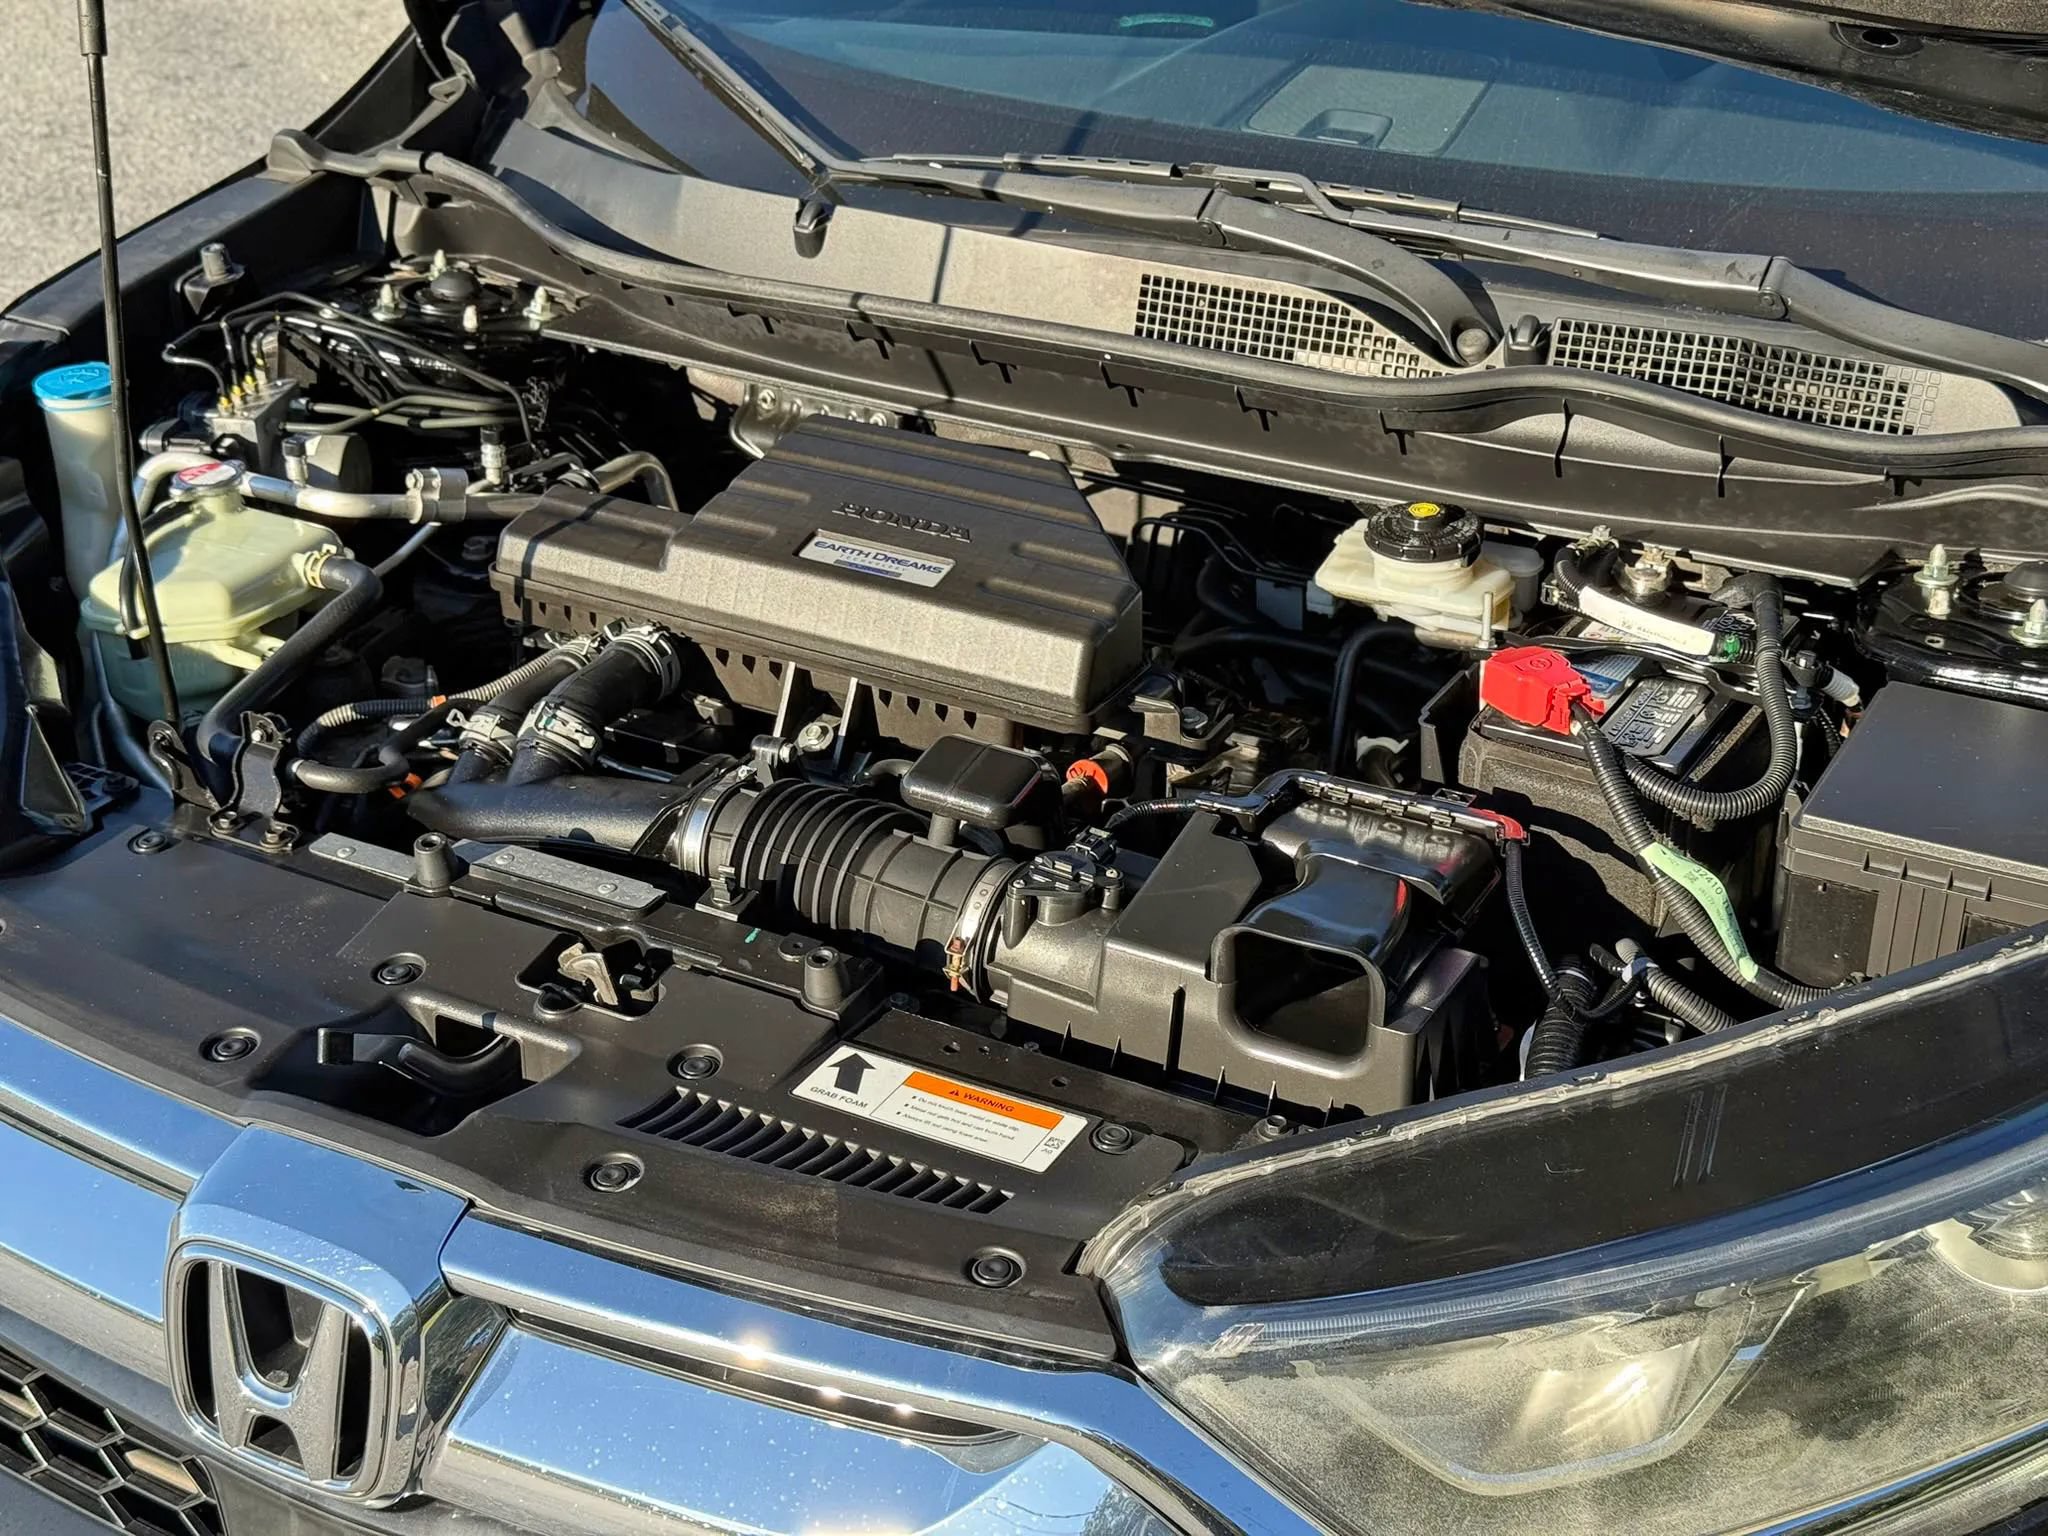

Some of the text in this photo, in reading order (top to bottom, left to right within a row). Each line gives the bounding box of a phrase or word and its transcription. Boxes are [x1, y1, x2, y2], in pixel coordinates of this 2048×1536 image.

[832, 502, 971, 542] HONDA
[813, 540, 944, 575] EARTH DREAMS
[810, 1085, 869, 1109] GRAB FOAM
[963, 1091, 1015, 1113] WARNING
